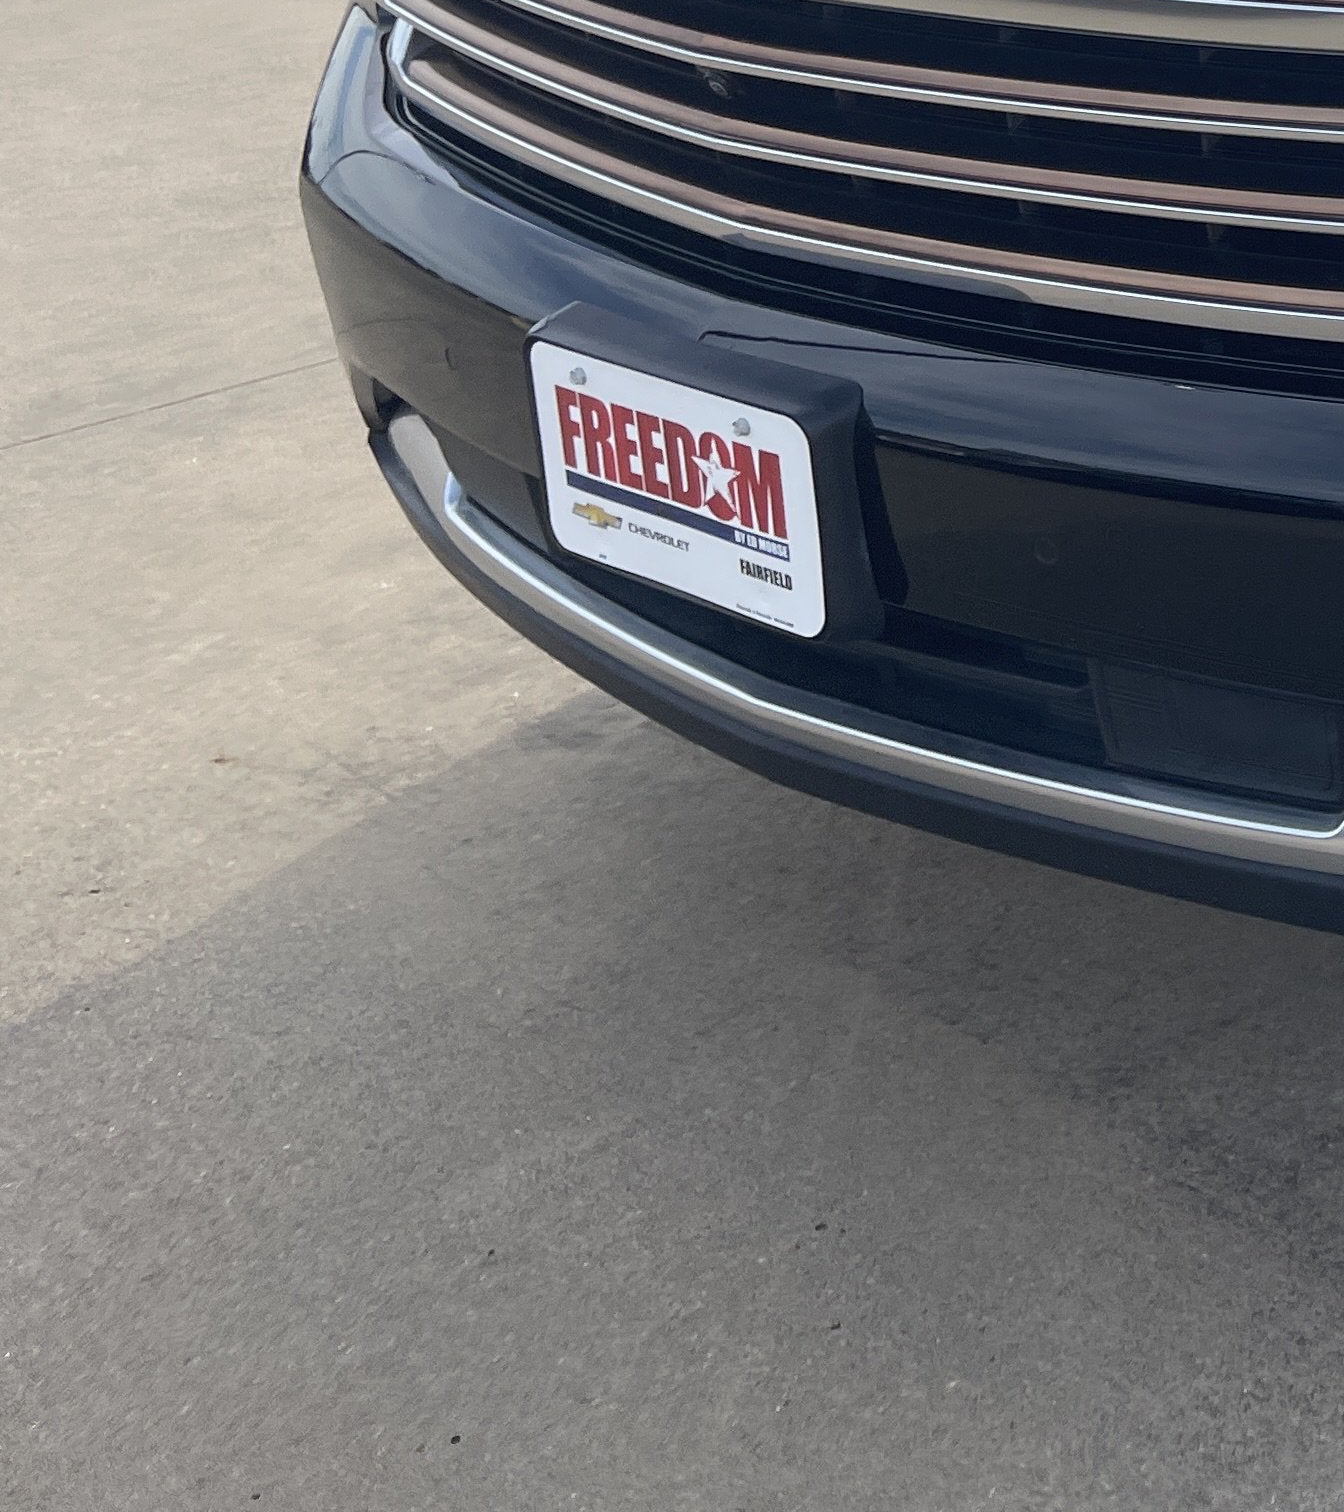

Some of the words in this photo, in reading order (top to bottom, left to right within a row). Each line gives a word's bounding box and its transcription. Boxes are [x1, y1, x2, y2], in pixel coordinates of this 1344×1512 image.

[555, 384, 789, 539] FREEDOM
[628, 522, 690, 553] CHEVROLET
[740, 558, 793, 591] FAIRFIELD
